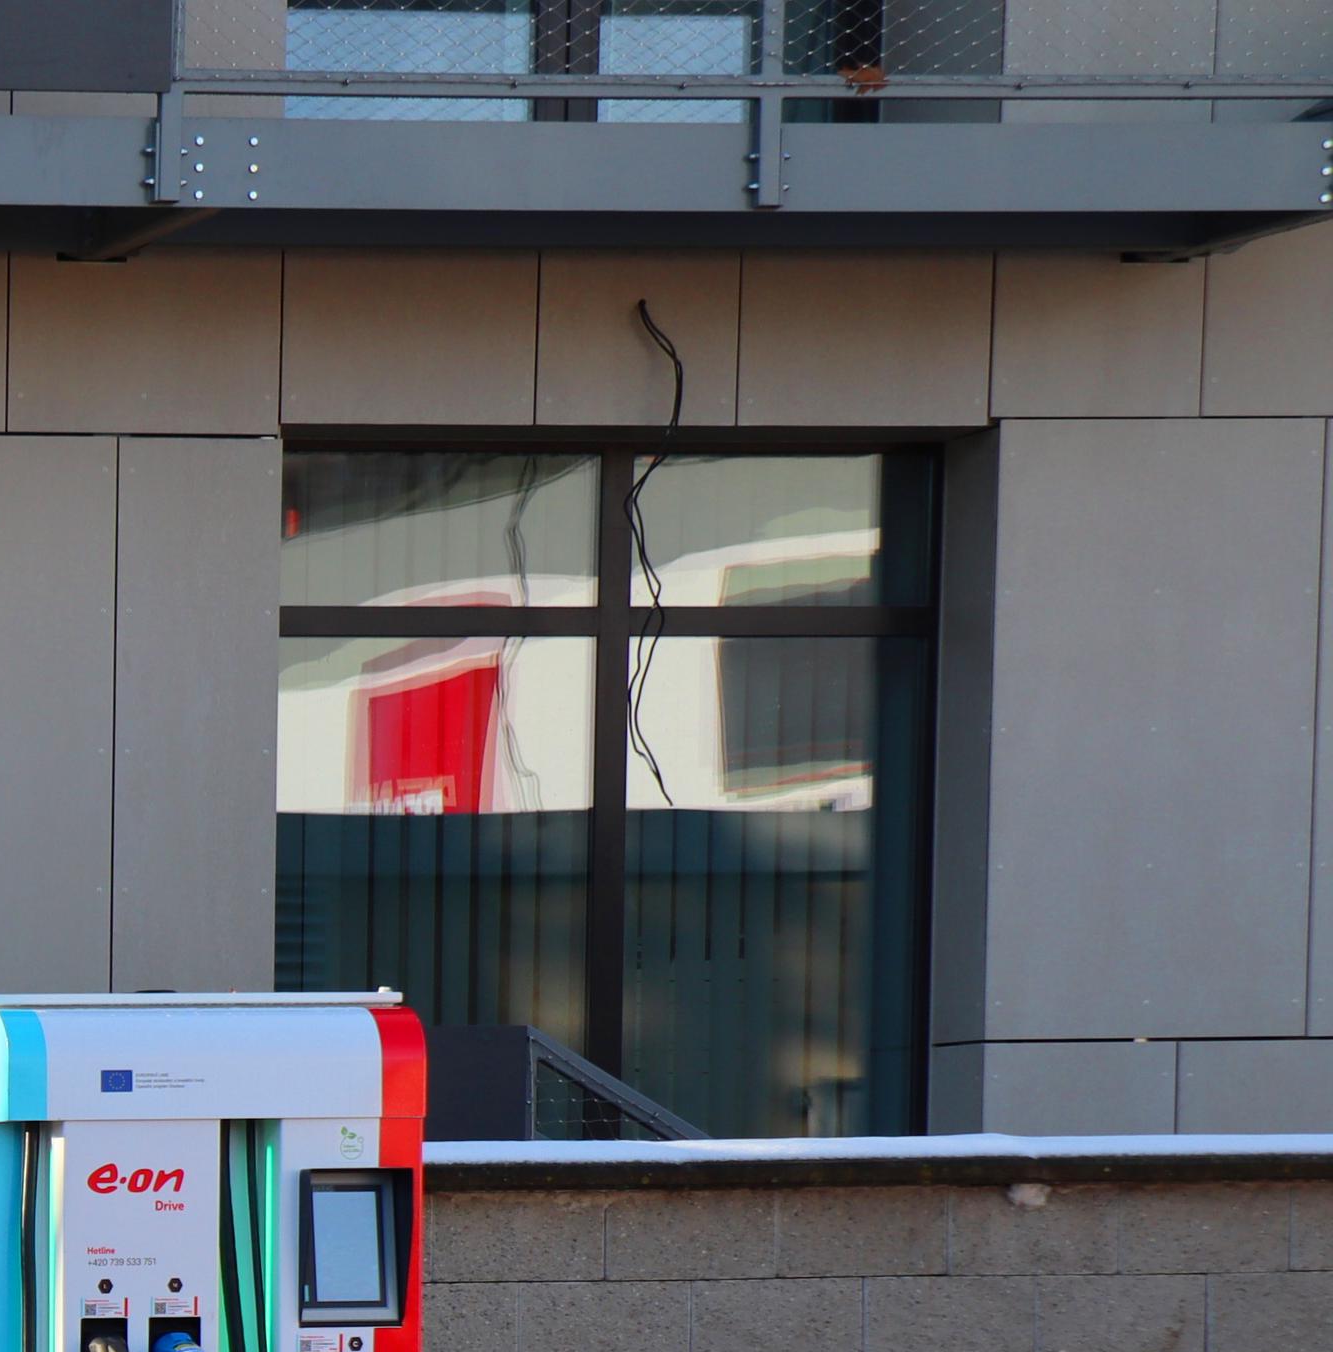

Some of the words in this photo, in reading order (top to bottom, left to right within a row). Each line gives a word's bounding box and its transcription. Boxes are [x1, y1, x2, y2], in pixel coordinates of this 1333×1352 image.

[154, 1199, 185, 1212] Drive
[86, 1246, 116, 1256] Hotline
[87, 1258, 109, 1267] +420
[109, 1257, 125, 1267] 739
[126, 1257, 142, 1267] 533
[143, 1256, 157, 1266] 751
